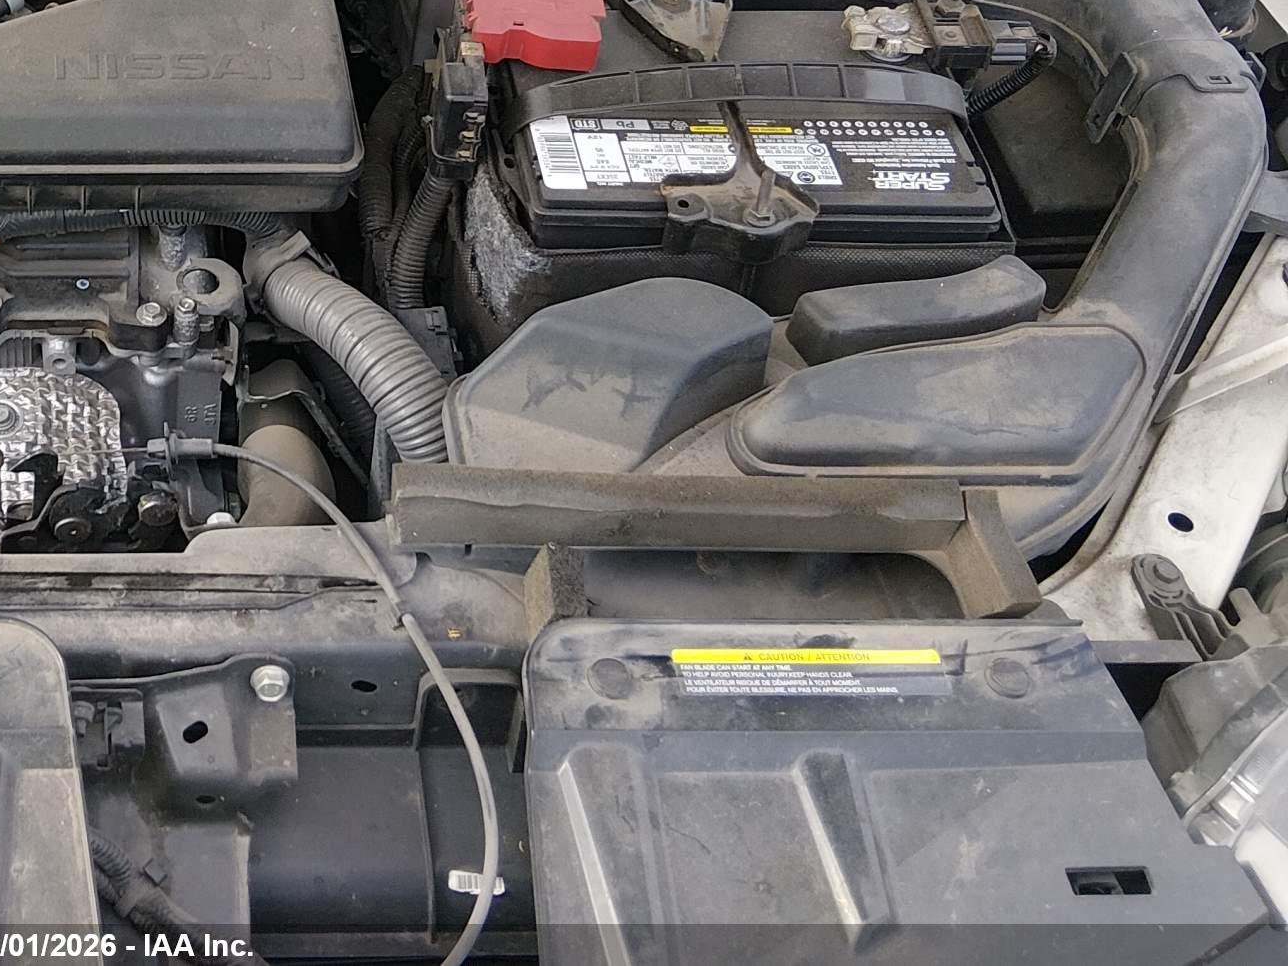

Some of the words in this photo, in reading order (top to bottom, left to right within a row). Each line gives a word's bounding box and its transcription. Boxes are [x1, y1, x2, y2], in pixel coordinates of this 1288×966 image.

[54, 51, 305, 81] NISSAN
[616, 120, 635, 129] Pb
[877, 172, 950, 183] START
[875, 181, 945, 191] SUPER
[758, 653, 804, 661] CAUTION
[815, 653, 870, 661] ATTENTION
[707, 685, 728, 693] ÉVITER
